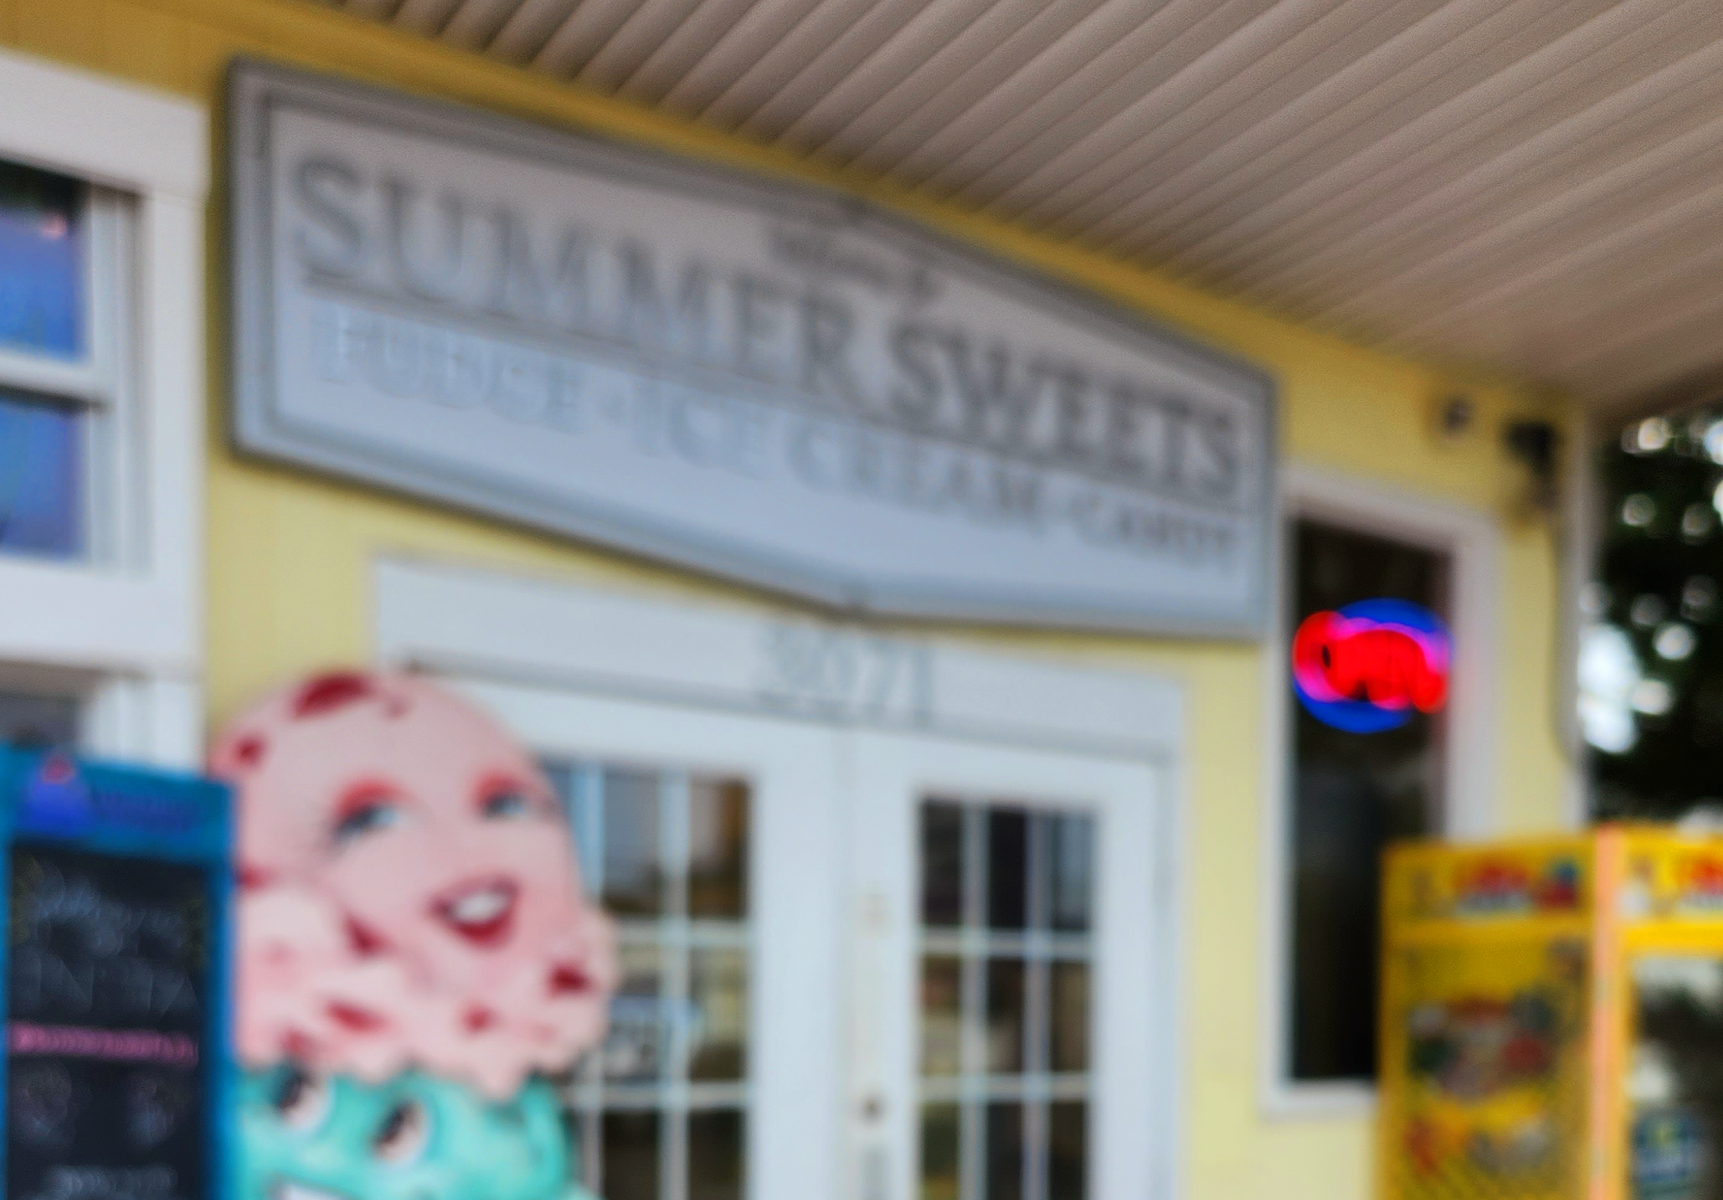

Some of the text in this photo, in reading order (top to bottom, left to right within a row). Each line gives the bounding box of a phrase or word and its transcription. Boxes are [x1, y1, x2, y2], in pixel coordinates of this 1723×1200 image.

[293, 155, 1243, 502] SUMMER SWEETS
[309, 304, 587, 437] FUDGE
[785, 414, 1052, 538] CREAM
